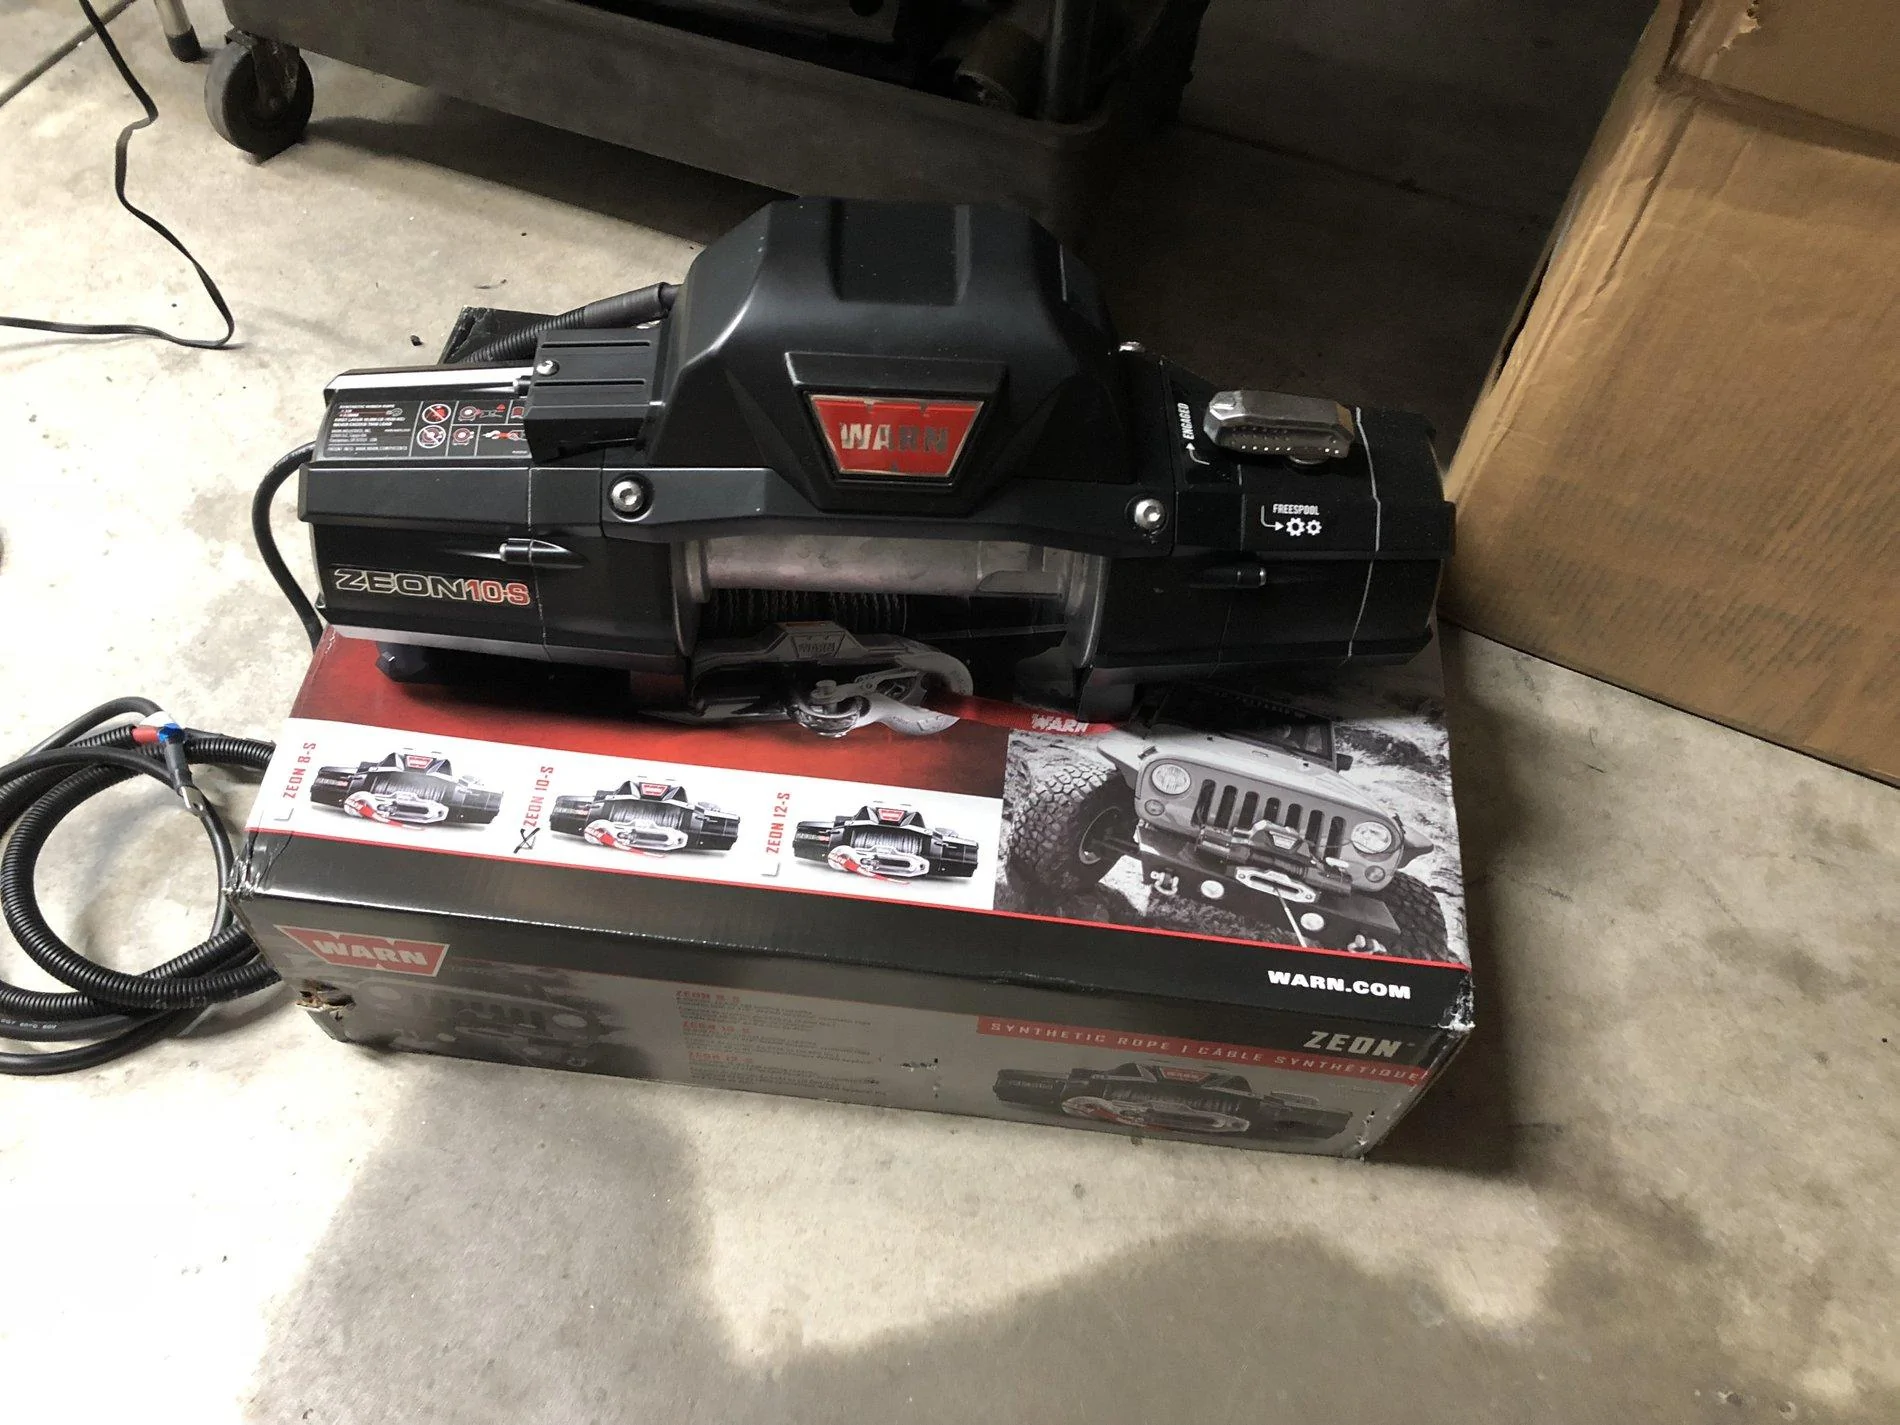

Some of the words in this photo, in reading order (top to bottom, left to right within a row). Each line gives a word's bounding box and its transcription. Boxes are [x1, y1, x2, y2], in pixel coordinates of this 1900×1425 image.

[1177, 402, 1194, 440] ENGAGED
[839, 421, 949, 452] WARN
[1272, 503, 1320, 516] FREESPOOL
[1031, 713, 1090, 733] WARN
[283, 768, 306, 798] ZEON
[297, 742, 316, 763] 8-S
[523, 795, 544, 828] ZEON
[535, 766, 553, 791] 10-S
[772, 792, 791, 818] 12-S
[766, 822, 785, 854] ZEON
[313, 939, 429, 966] WARN
[1267, 970, 1411, 1000] WARN.COM
[991, 1022, 1105, 1043] SYNTHETIC
[1117, 1036, 1170, 1051] ROPE
[1303, 1030, 1402, 1058] ZEON
